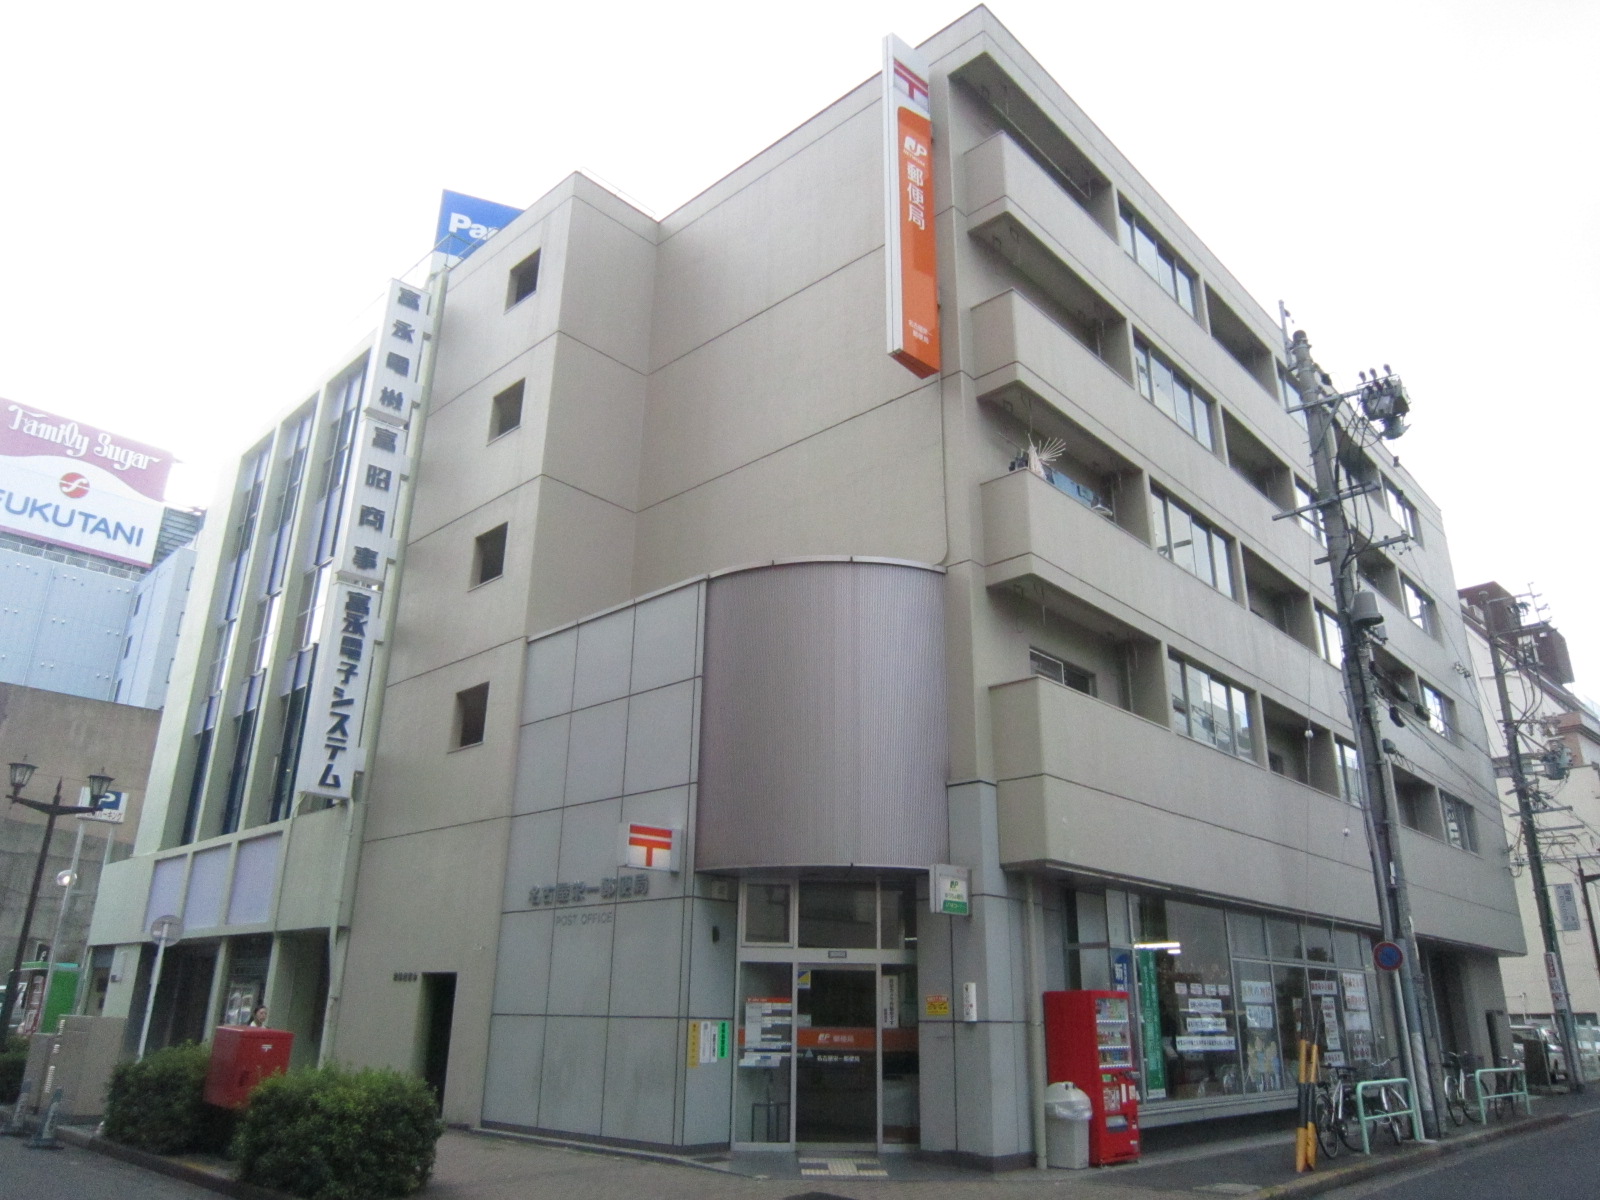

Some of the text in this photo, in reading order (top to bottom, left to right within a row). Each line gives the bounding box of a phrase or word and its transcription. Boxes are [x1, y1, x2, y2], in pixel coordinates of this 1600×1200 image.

[907, 162, 925, 231] 郵便局
[8, 405, 160, 470] Family Sugar
[556, 911, 612, 926] POST OFFICE
